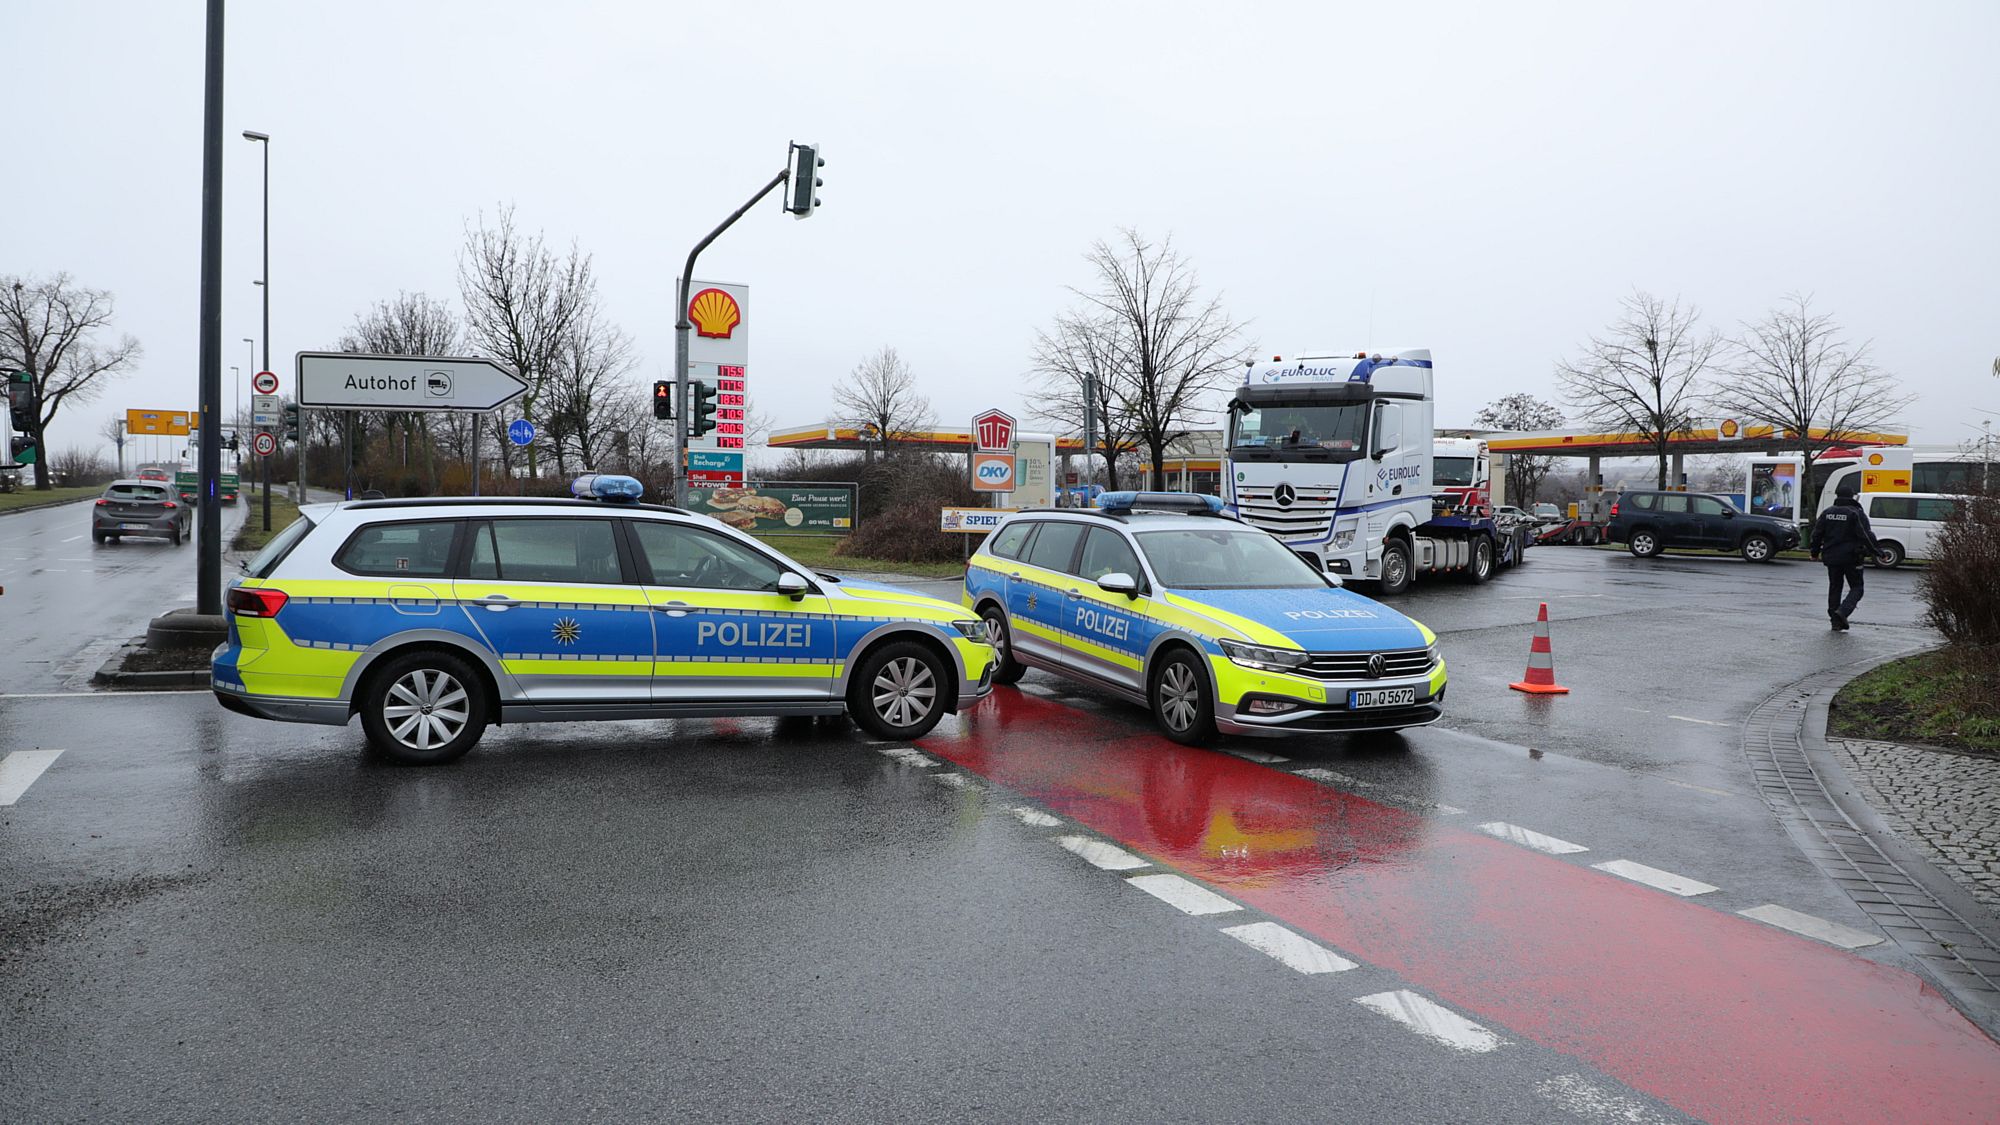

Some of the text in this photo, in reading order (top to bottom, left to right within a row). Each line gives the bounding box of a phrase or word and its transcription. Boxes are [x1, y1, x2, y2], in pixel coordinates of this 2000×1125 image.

[1281, 368, 1336, 376] EUROLUC
[344, 374, 416, 390] Autohof
[978, 414, 1012, 449] UTA
[258, 438, 270, 449] 60
[693, 460, 726, 468] Recharge
[979, 466, 1009, 478] DKV
[1388, 465, 1420, 480] EUROLUC
[791, 494, 806, 502] Eine
[808, 494, 828, 502] Pause
[966, 515, 1003, 525] SPIEL
[1826, 513, 1847, 521] POLIZEI
[1283, 610, 1378, 620] POLIZEI
[1076, 606, 1129, 641] POLIZEI
[698, 622, 811, 647] POLIZEI
[1357, 690, 1413, 706] DD Q 5672
